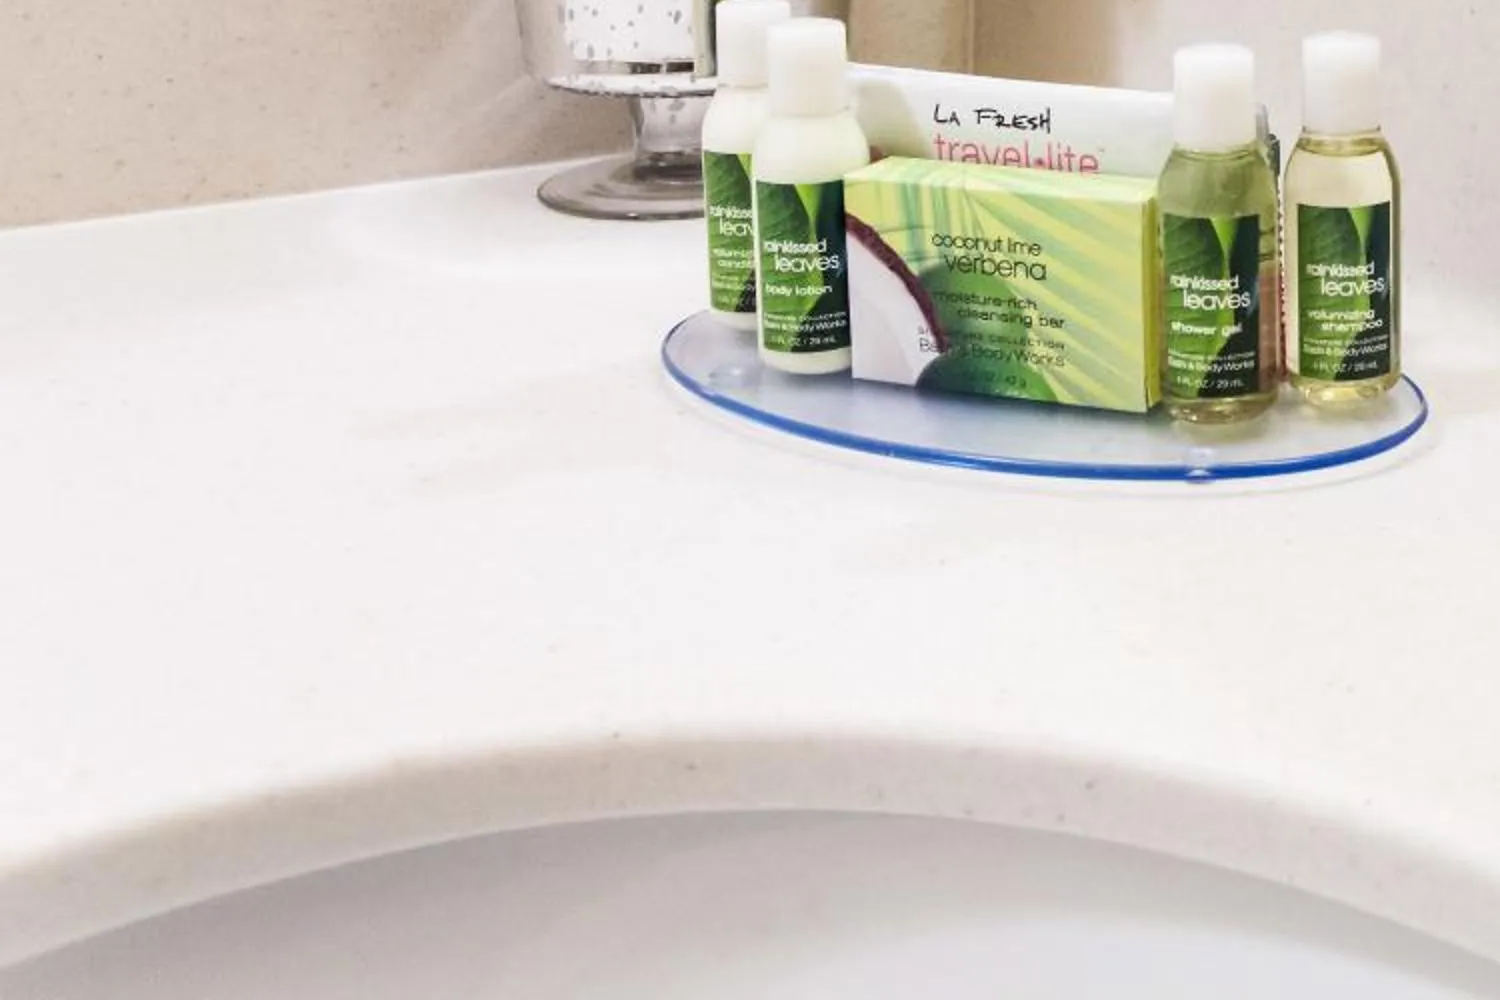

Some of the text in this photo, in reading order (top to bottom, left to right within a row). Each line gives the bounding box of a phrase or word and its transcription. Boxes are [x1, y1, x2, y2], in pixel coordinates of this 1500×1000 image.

[932, 103, 1051, 134] LA FRESH
[931, 233, 1042, 256] coconut lime
[774, 254, 841, 273] leaves
[944, 254, 1047, 281] verbena
[765, 283, 793, 297] body
[795, 284, 833, 296] lotion
[1321, 277, 1385, 297] leaves
[1183, 289, 1251, 311] leaves
[957, 307, 1066, 329] cleansing bar
[1171, 321, 1217, 335] shower
